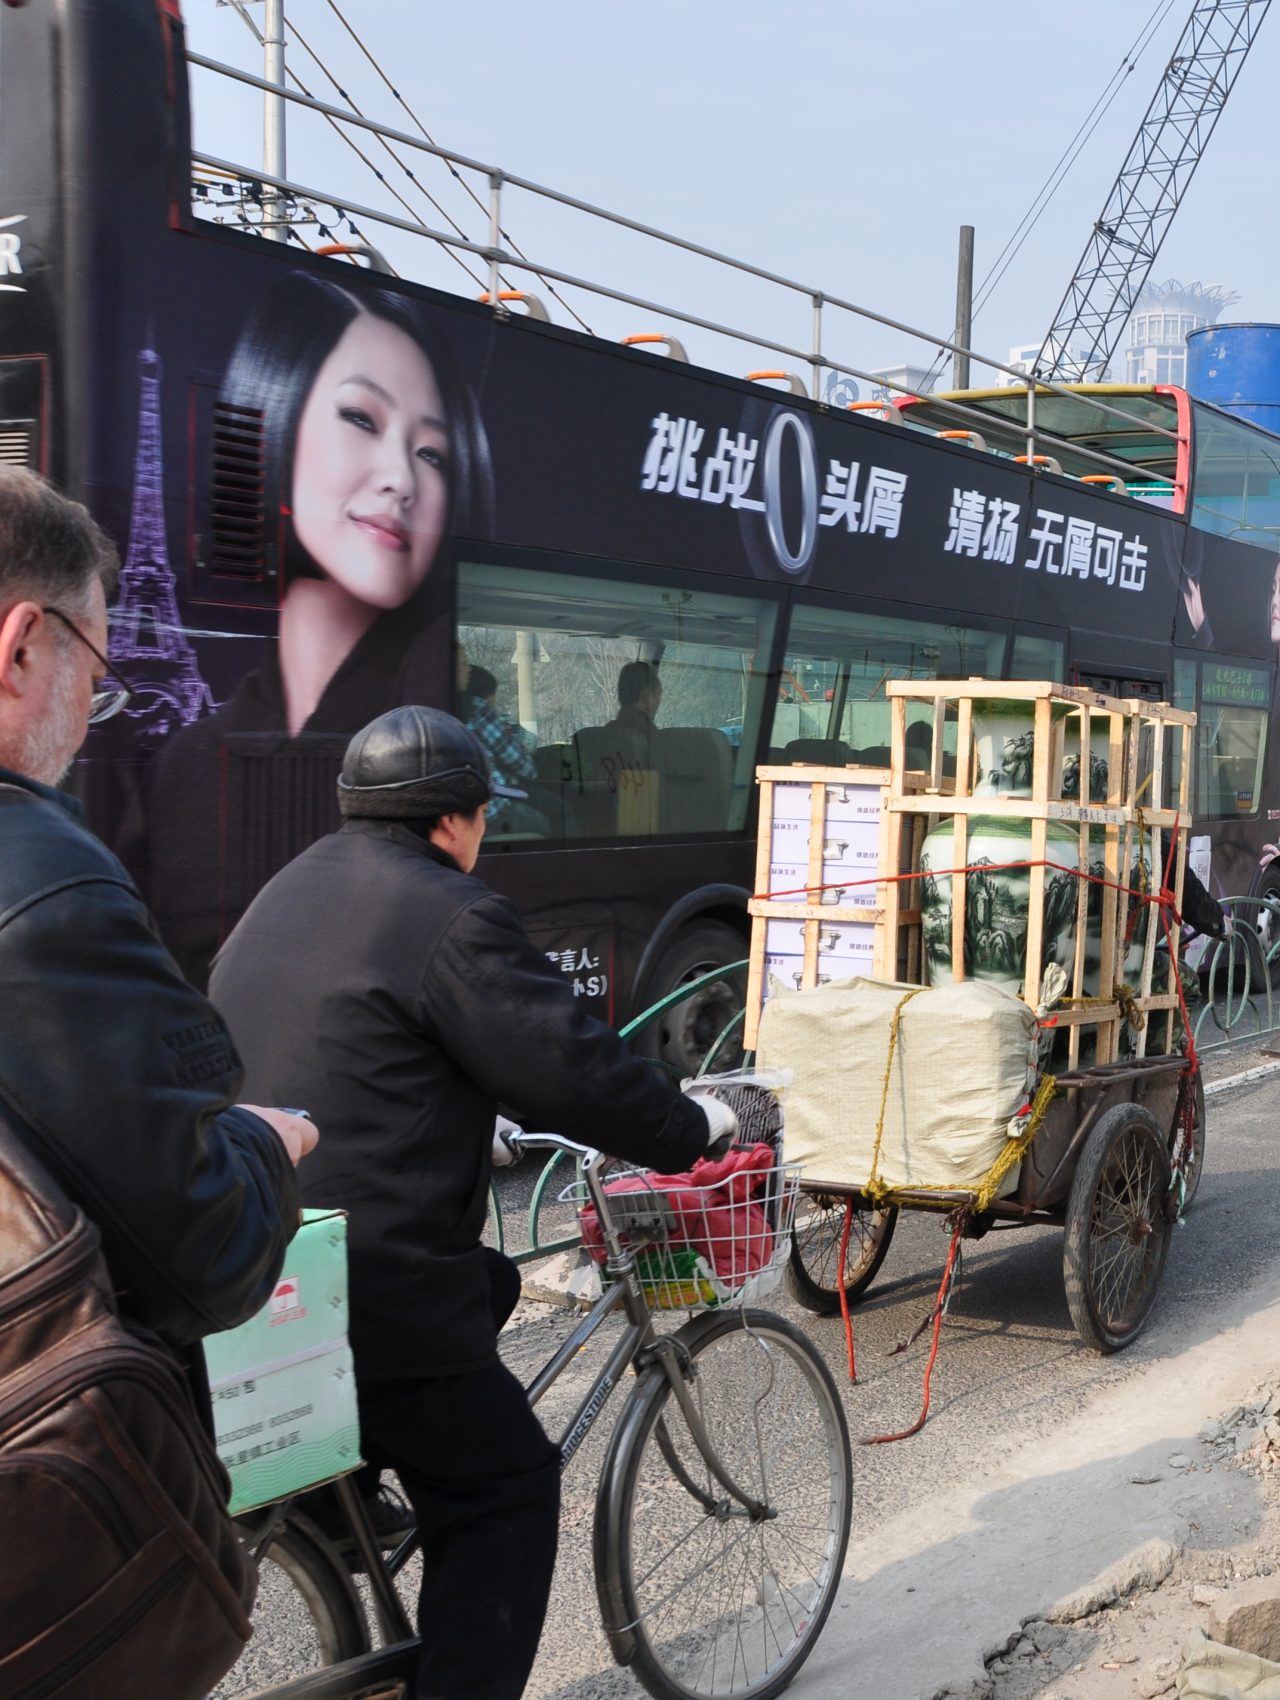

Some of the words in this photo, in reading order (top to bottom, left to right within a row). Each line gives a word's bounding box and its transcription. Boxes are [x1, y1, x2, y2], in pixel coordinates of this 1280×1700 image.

[944, 487, 1021, 565] 清扬
[1024, 508, 1149, 592] 无屑可击
